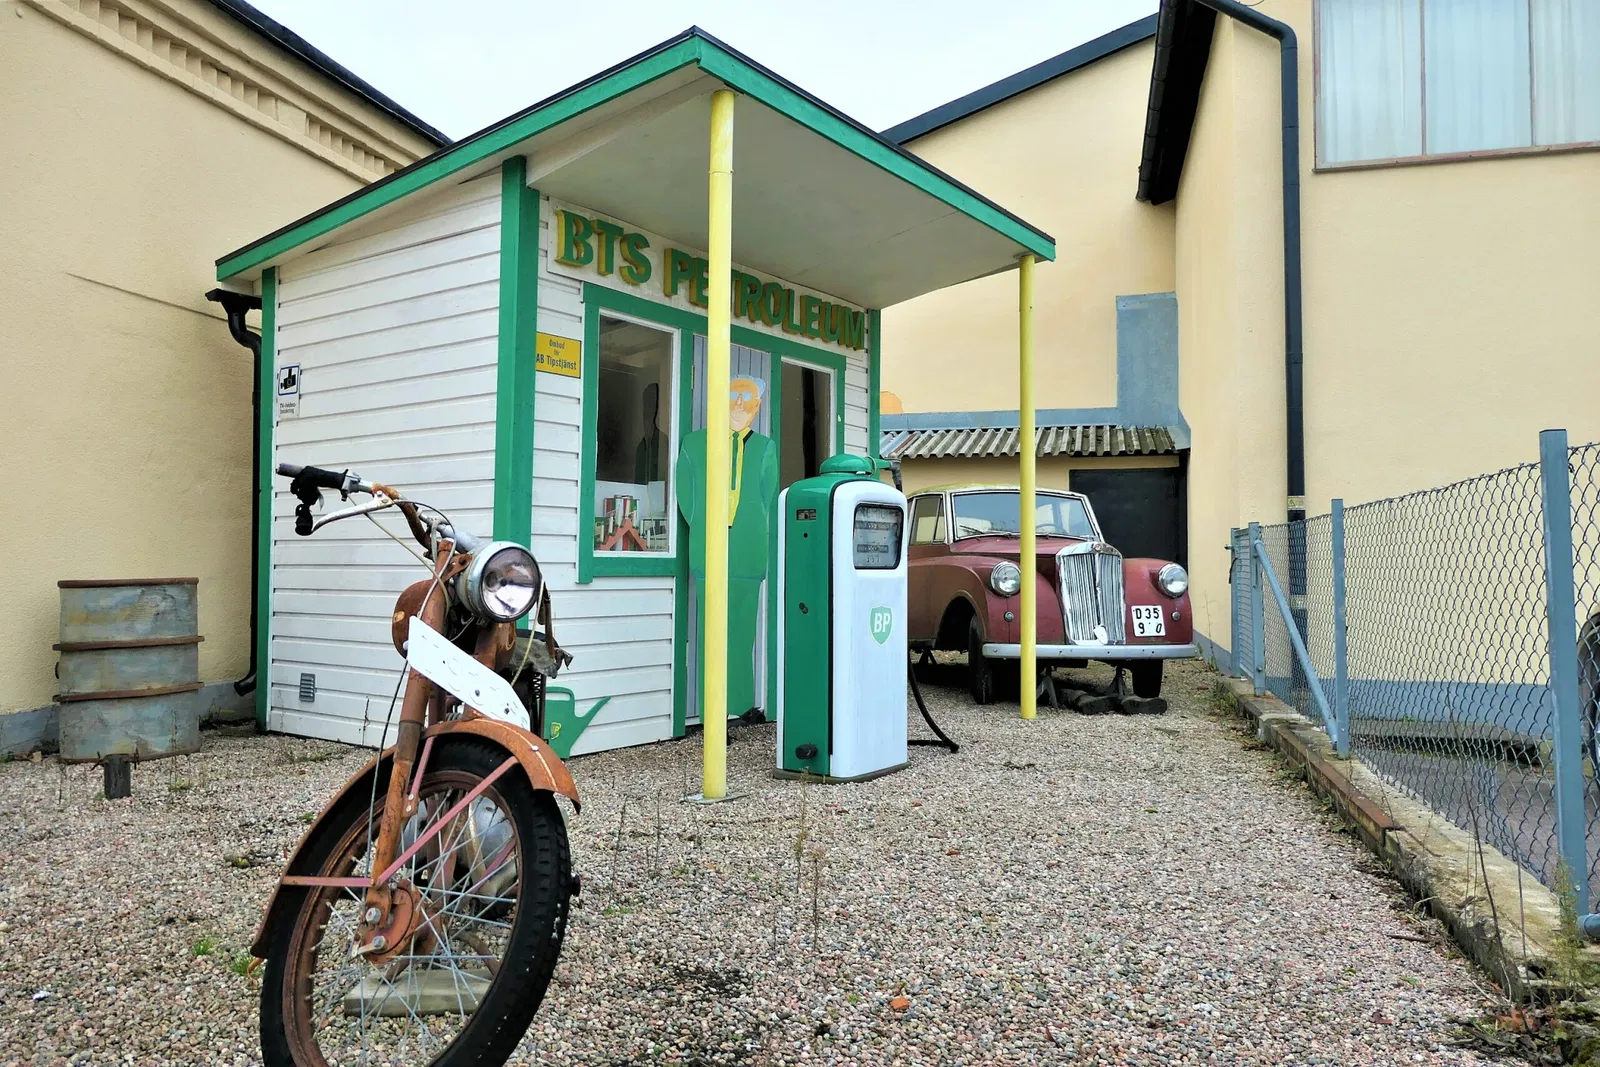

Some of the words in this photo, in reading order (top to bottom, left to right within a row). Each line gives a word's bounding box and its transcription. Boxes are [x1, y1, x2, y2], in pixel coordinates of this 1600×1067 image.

[554, 209, 652, 286] BTS
[664, 247, 865, 351] PEROLEUM
[536, 353, 545, 363] AB
[546, 355, 577, 370] Tipstjänst
[873, 612, 891, 634] BP
